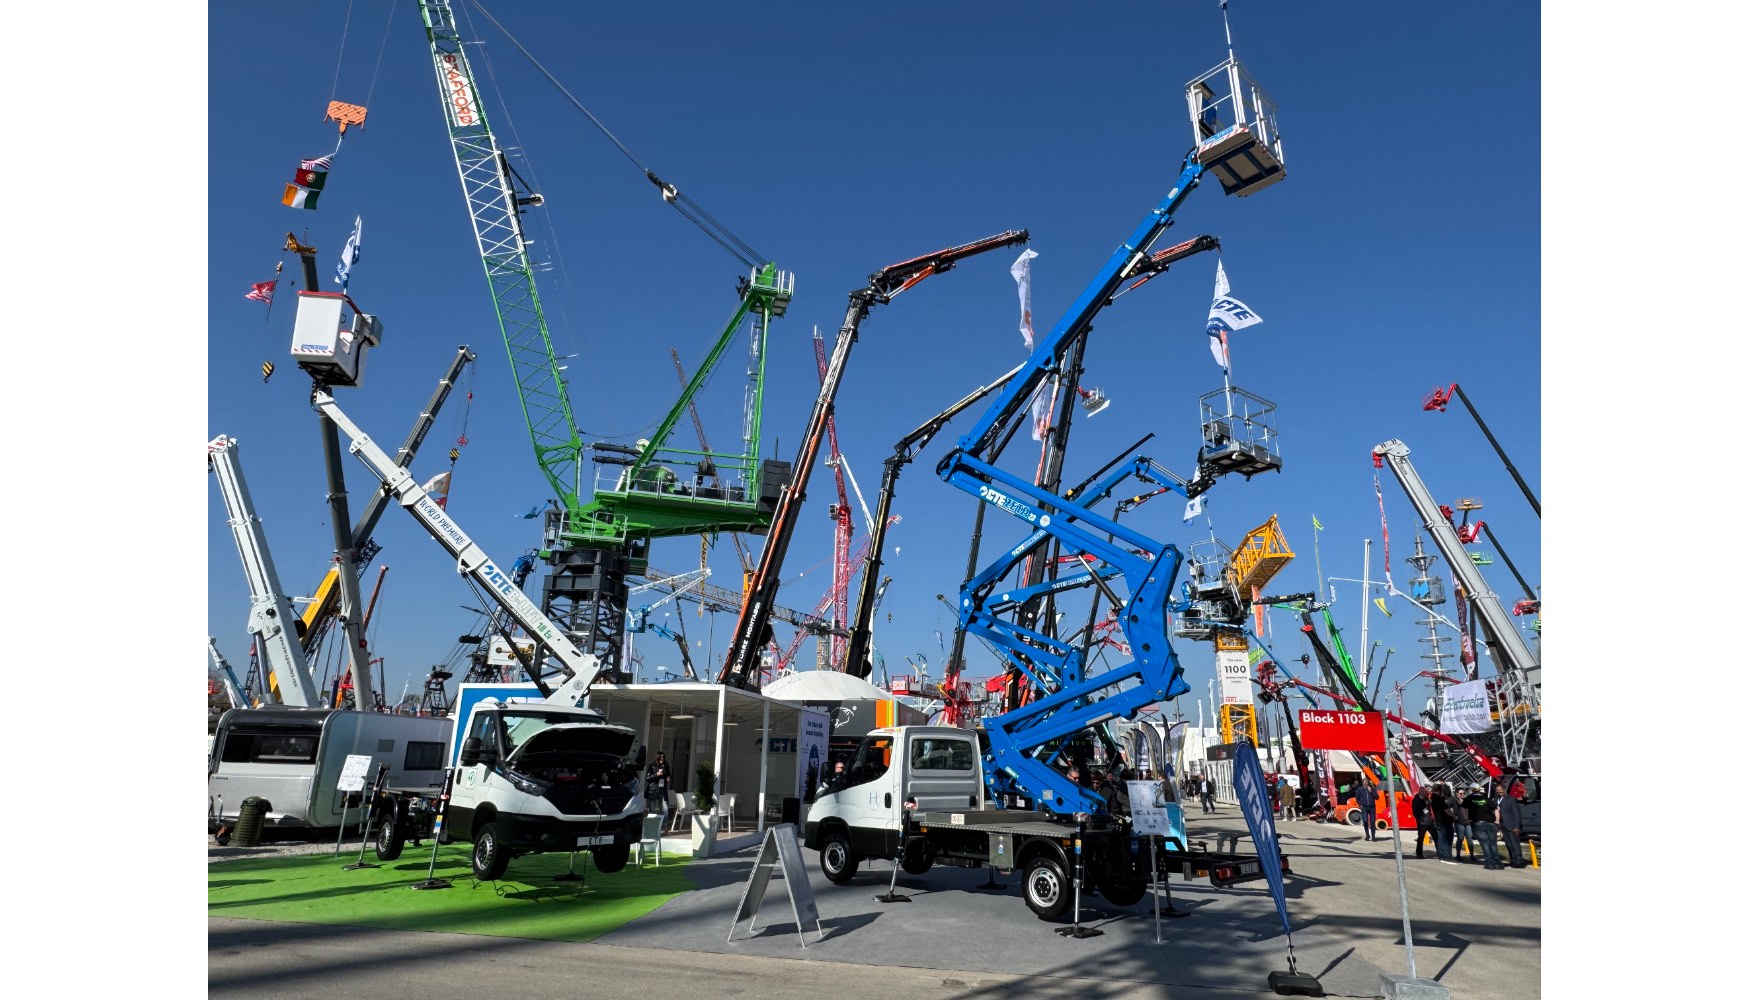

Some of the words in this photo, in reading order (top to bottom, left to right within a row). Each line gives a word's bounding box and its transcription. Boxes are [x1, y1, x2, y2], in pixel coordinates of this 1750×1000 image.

[444, 54, 473, 124] STAFFORD
[1213, 299, 1255, 321] CTE
[986, 489, 1006, 506] CTE
[1003, 497, 1030, 519] ZETA
[420, 499, 441, 521] WORLD
[437, 518, 466, 546] PREMIERE
[490, 571, 515, 596] CTE
[745, 601, 761, 638] MONTAGGI
[1224, 665, 1247, 674] 1100
[1302, 712, 1335, 724] Block
[1337, 713, 1366, 725] 1103
[1314, 749, 1329, 797] HOEFLO
[1241, 762, 1263, 826] CTE
